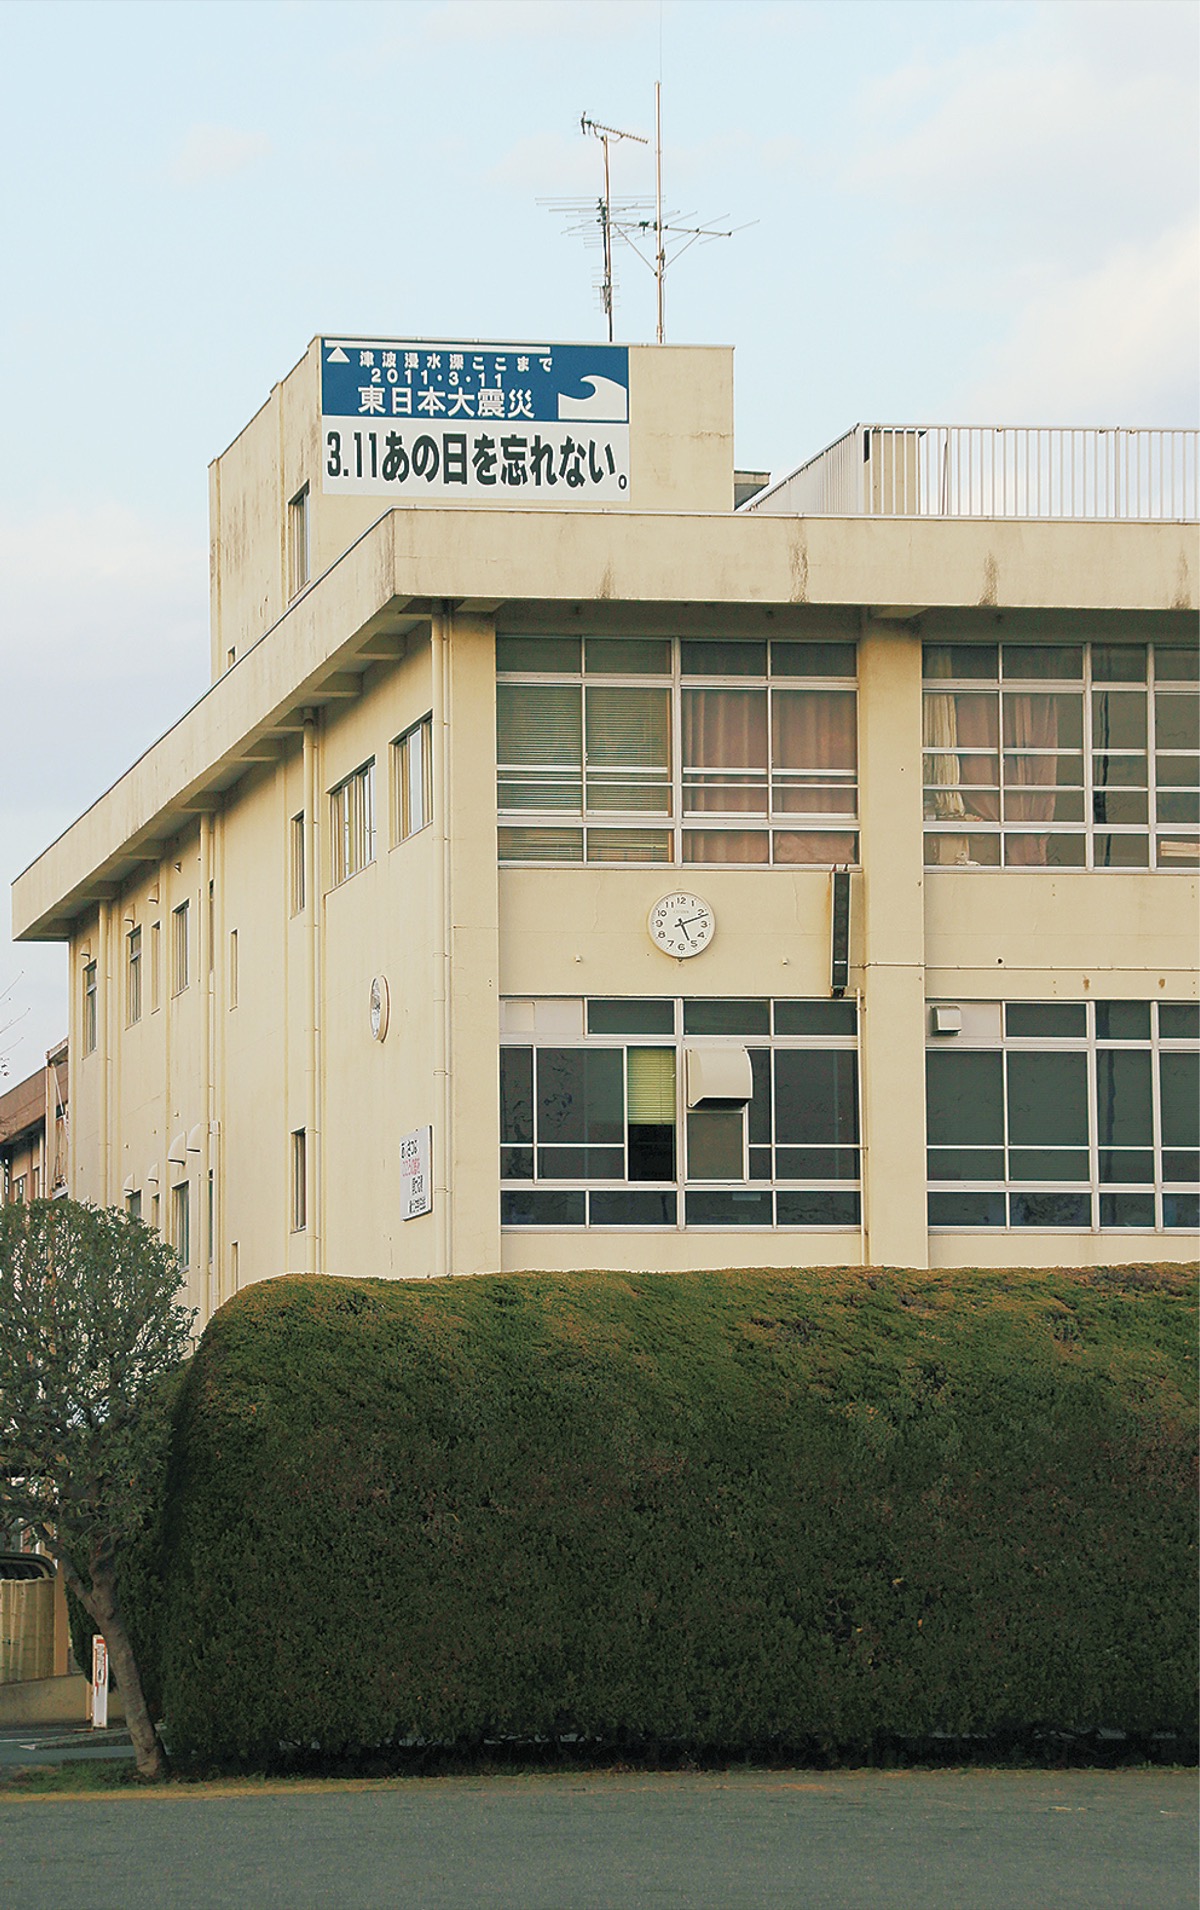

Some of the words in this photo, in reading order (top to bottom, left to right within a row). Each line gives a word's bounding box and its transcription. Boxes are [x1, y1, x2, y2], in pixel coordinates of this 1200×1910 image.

[356, 384, 535, 419] 東日本大震災
[326, 430, 628, 490] 3.11あの日を忘れない。
[657, 909, 667, 917] 10
[690, 940, 698, 948] 5
